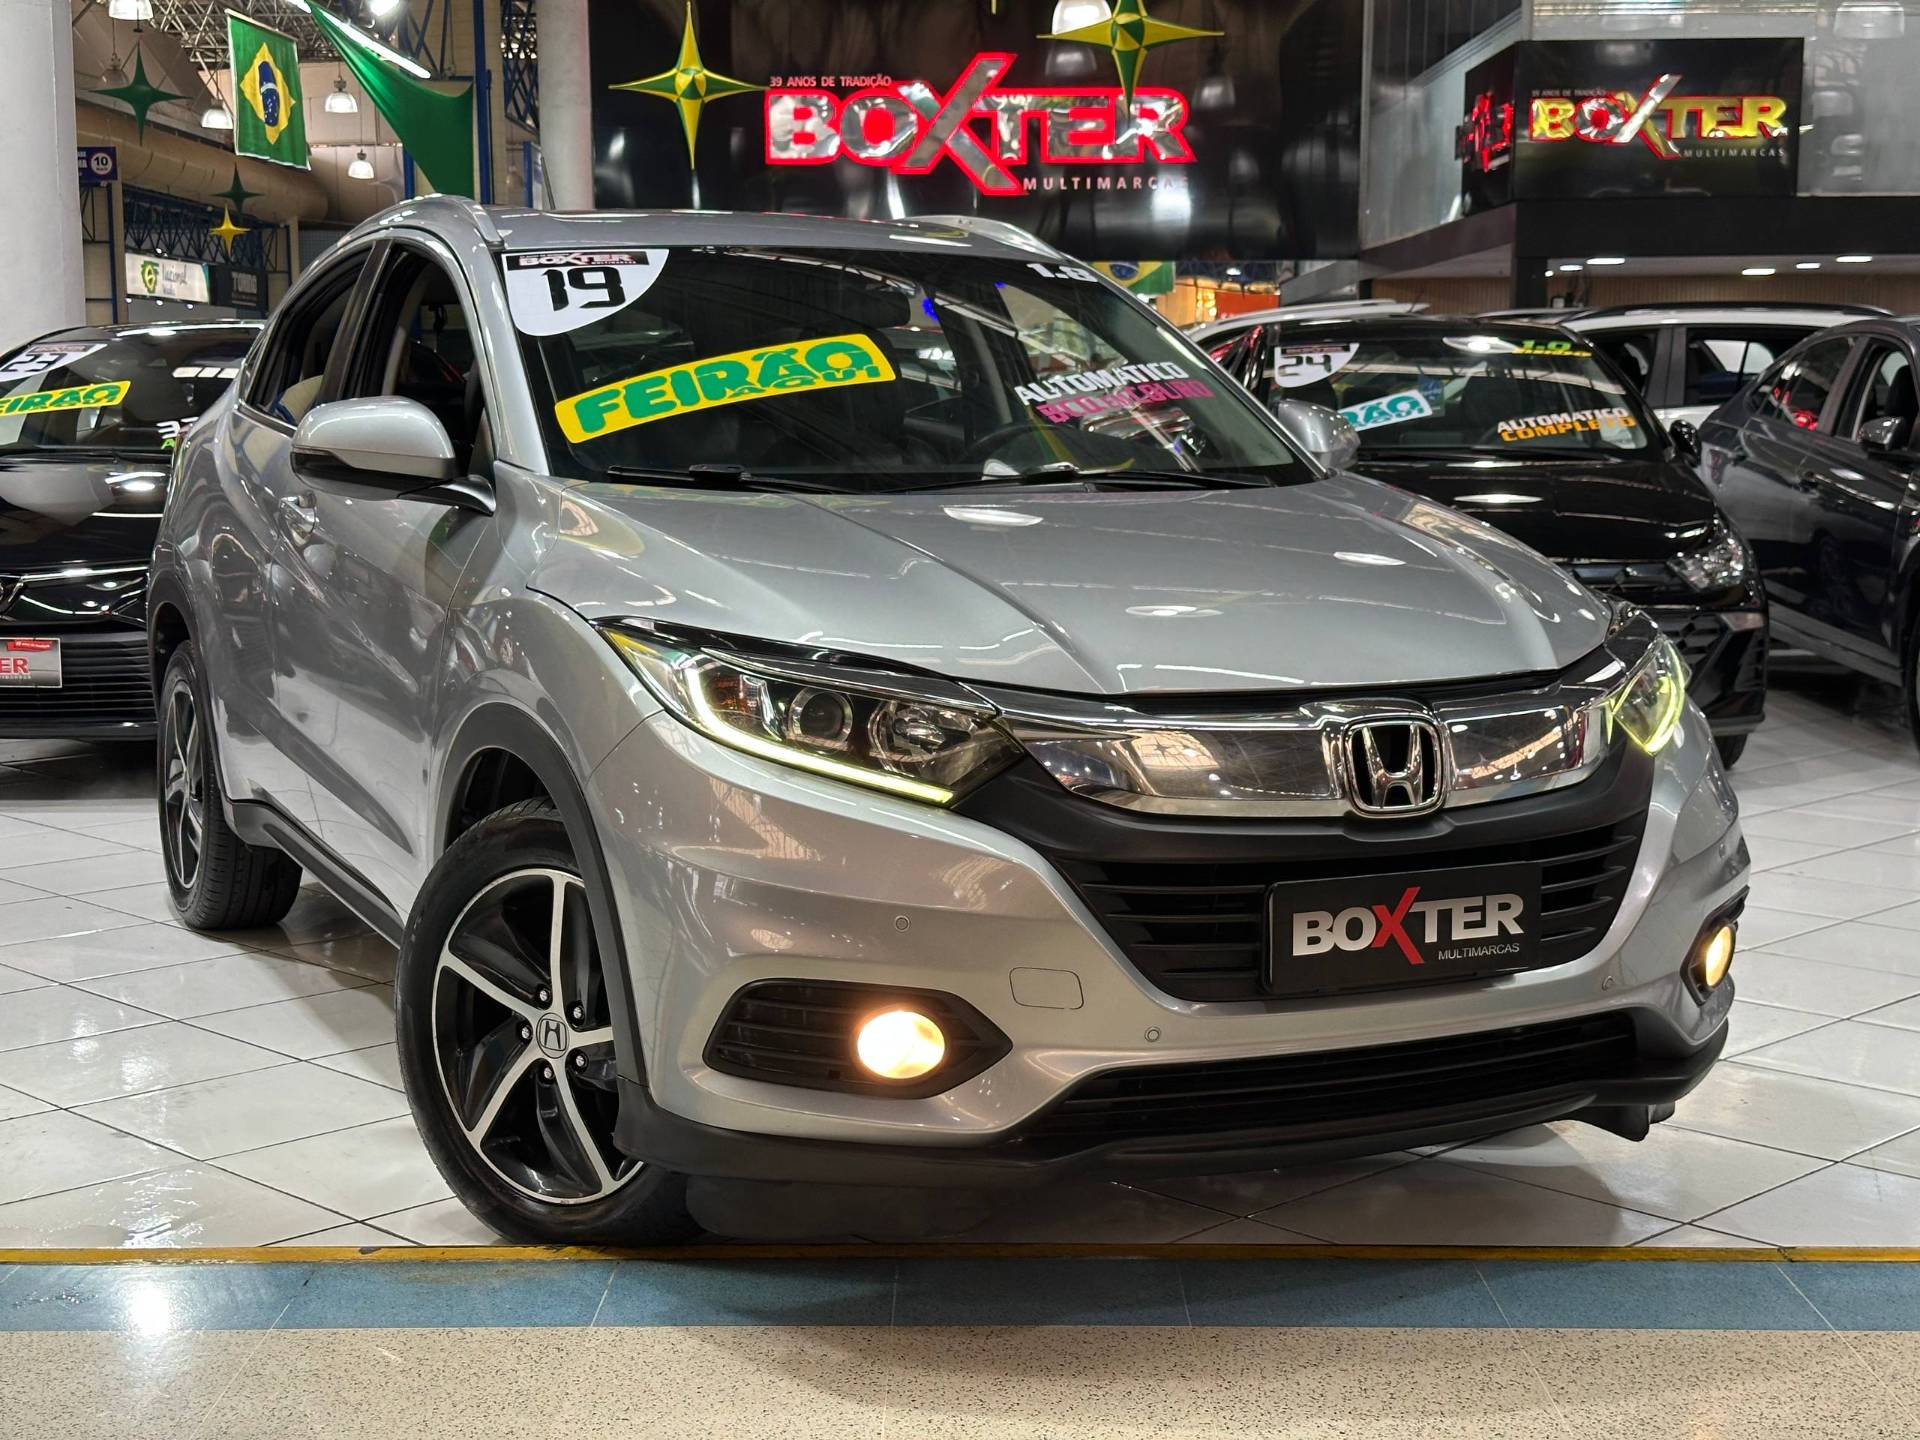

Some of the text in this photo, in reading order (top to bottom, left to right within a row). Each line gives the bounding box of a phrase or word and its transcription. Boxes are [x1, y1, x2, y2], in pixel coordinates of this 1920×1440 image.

[770, 74, 891, 88] 39 ANOS DE TRADIÇÃO
[765, 52, 1197, 195] BOXTER
[1528, 73, 1787, 160] BOXTER
[94, 156, 108, 166] 10
[1684, 148, 1785, 157] MULTIMARCAS
[1023, 177, 1189, 190] MULTIMARCAS
[541, 266, 626, 311] 19
[1, 353, 67, 372] 23
[1279, 355, 1332, 377] 24
[574, 340, 873, 434] FEIRÃO
[1500, 416, 1637, 442] COMPLETO
[1293, 886, 1525, 965] BOXTER
[1438, 942, 1520, 961] MULTIMARCAS
